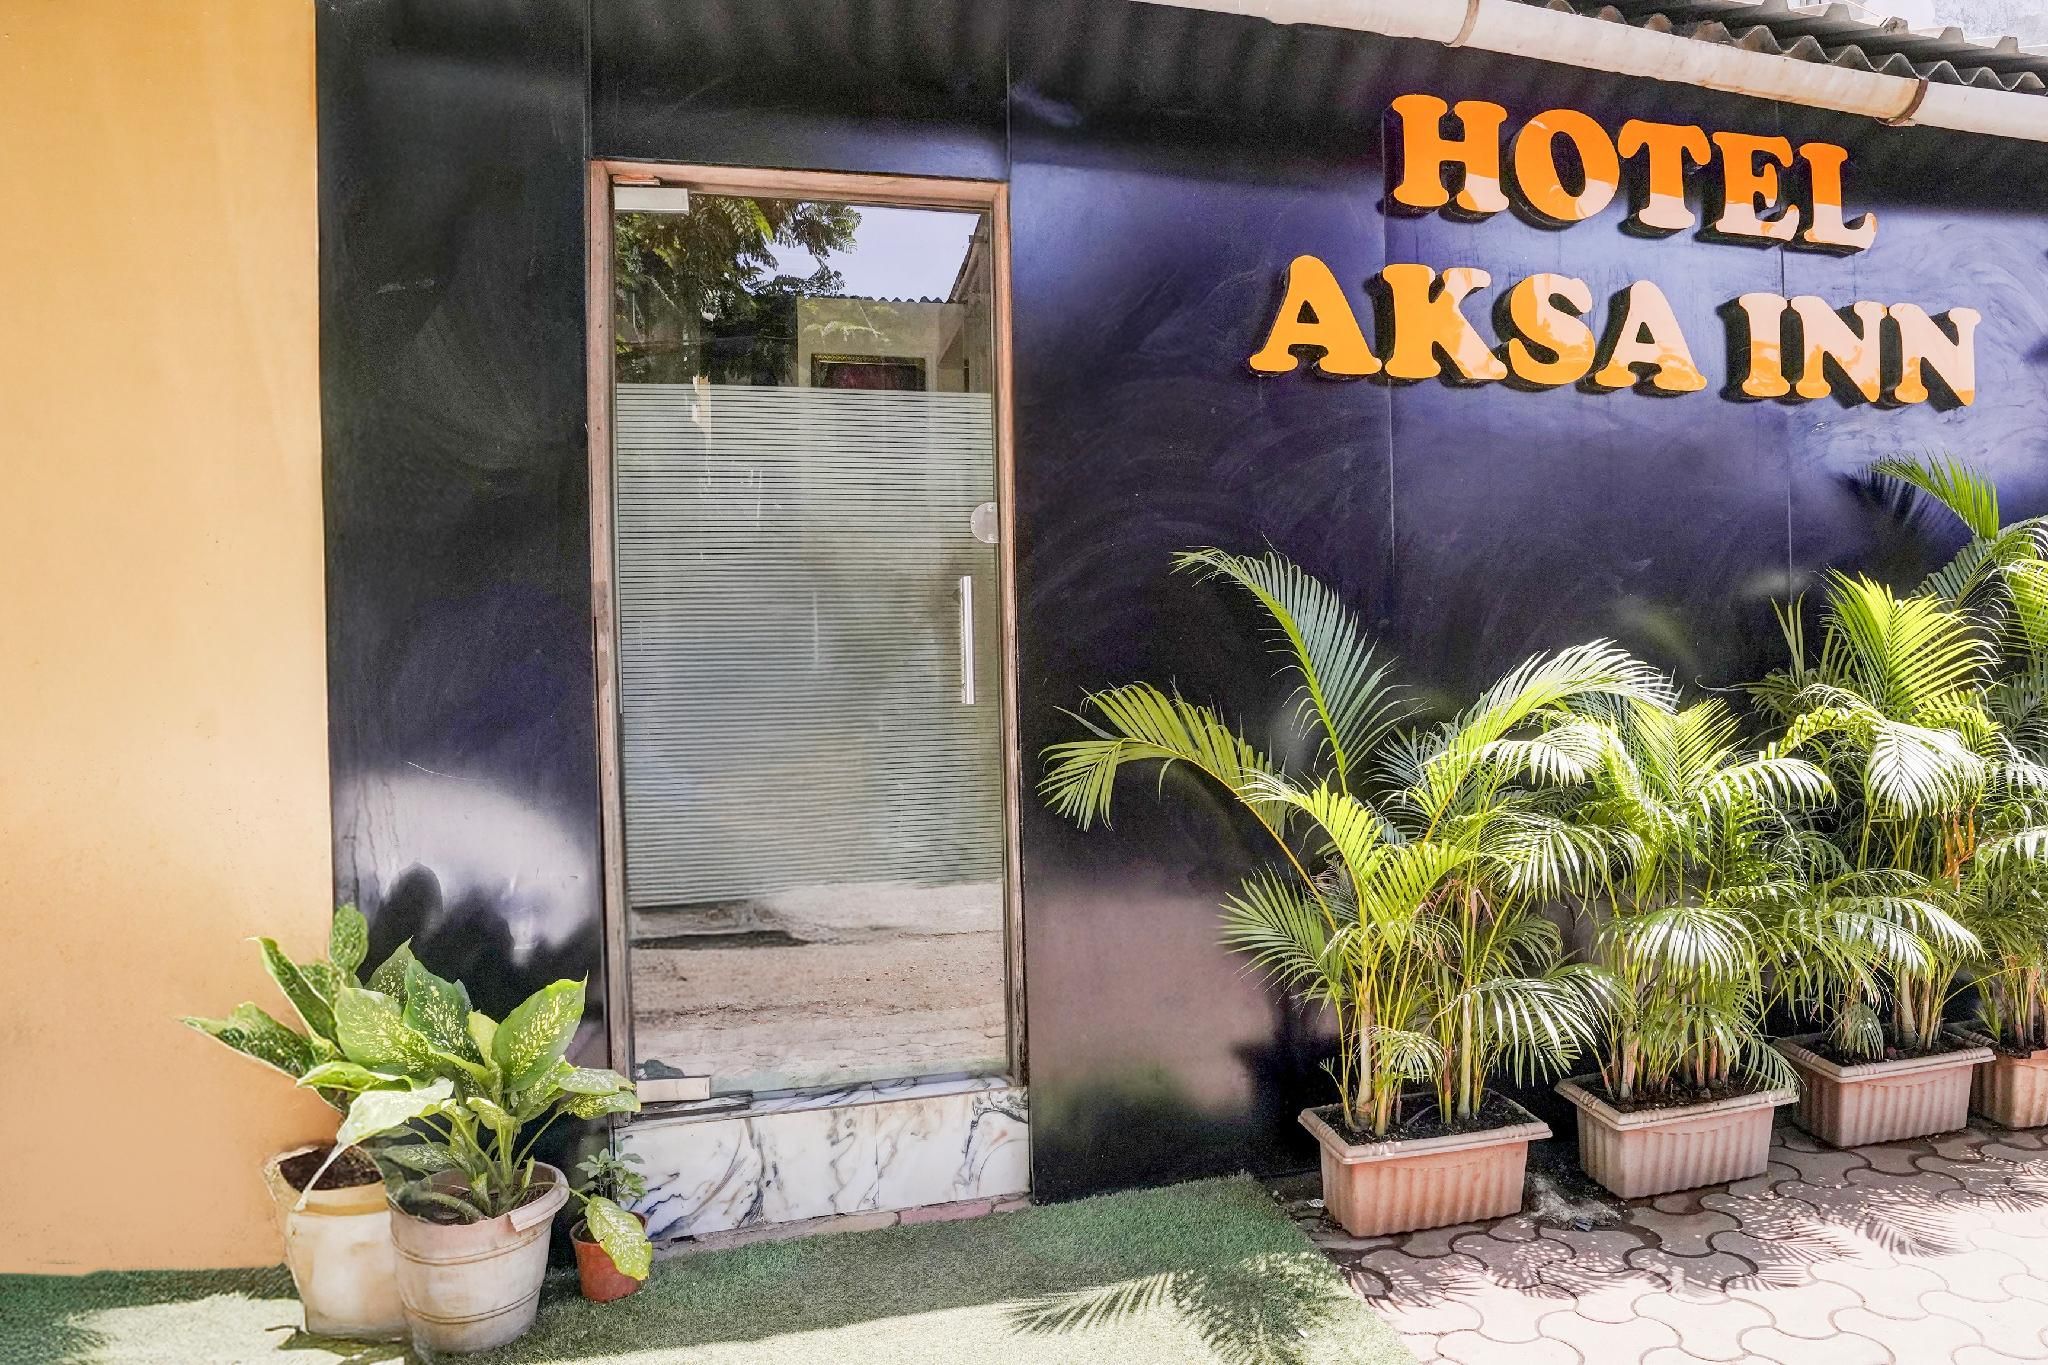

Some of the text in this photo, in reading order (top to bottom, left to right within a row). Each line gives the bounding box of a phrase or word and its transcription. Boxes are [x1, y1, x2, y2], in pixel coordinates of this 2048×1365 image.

[1391, 94, 1878, 252] HOTEL
[1248, 254, 1982, 408] AKSA INN
